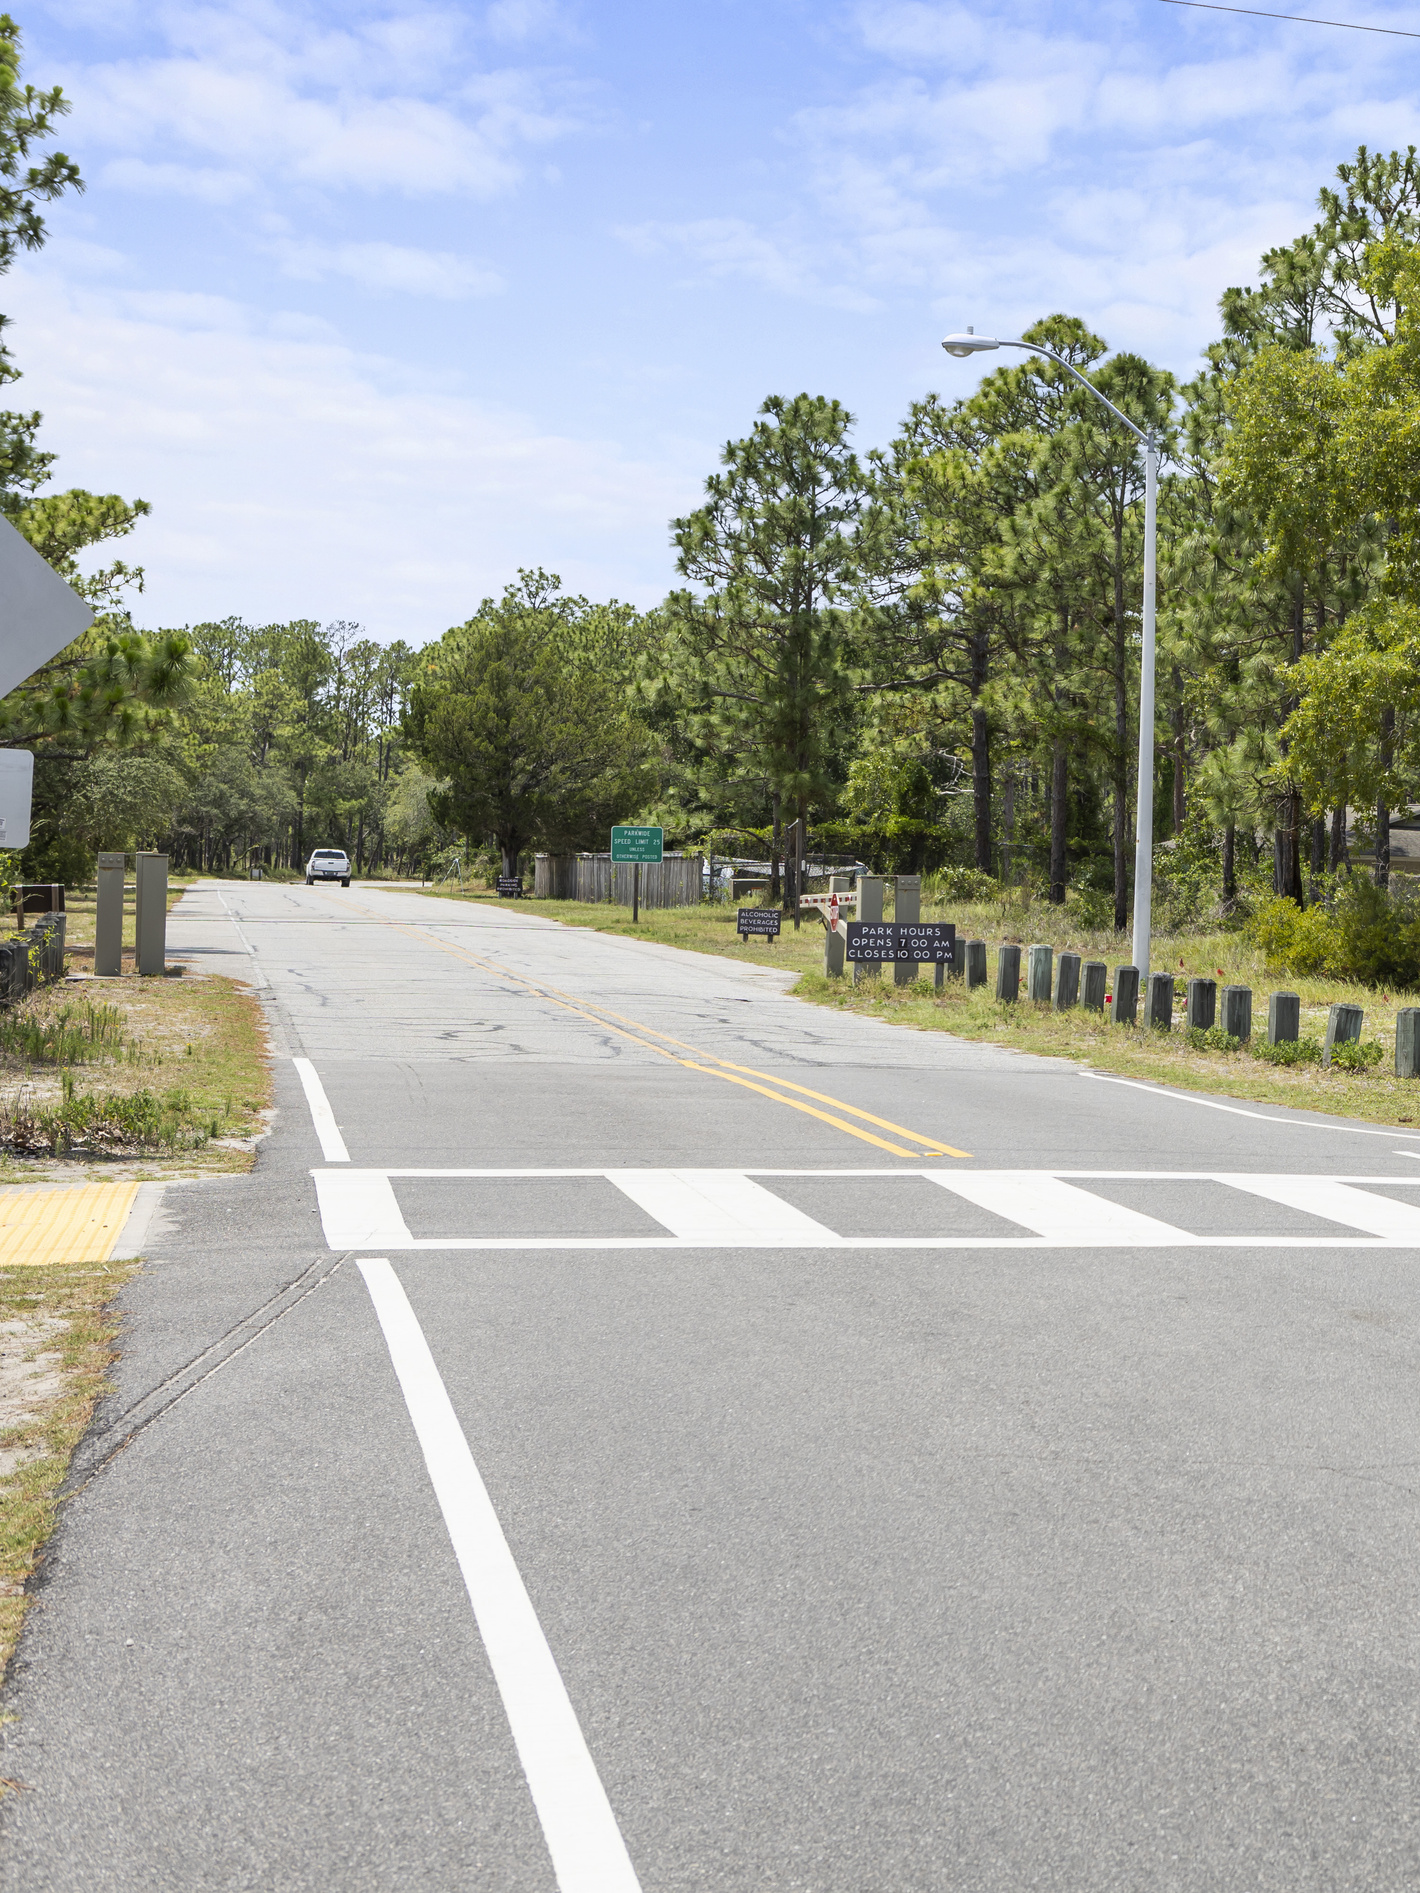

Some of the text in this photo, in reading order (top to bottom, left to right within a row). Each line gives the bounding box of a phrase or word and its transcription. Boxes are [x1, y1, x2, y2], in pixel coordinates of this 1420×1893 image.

[862, 927, 941, 936] PARK HOURS
[852, 938, 892, 947] OPENS
[848, 949, 894, 958] CLOSES
[936, 950, 953, 959] PM
